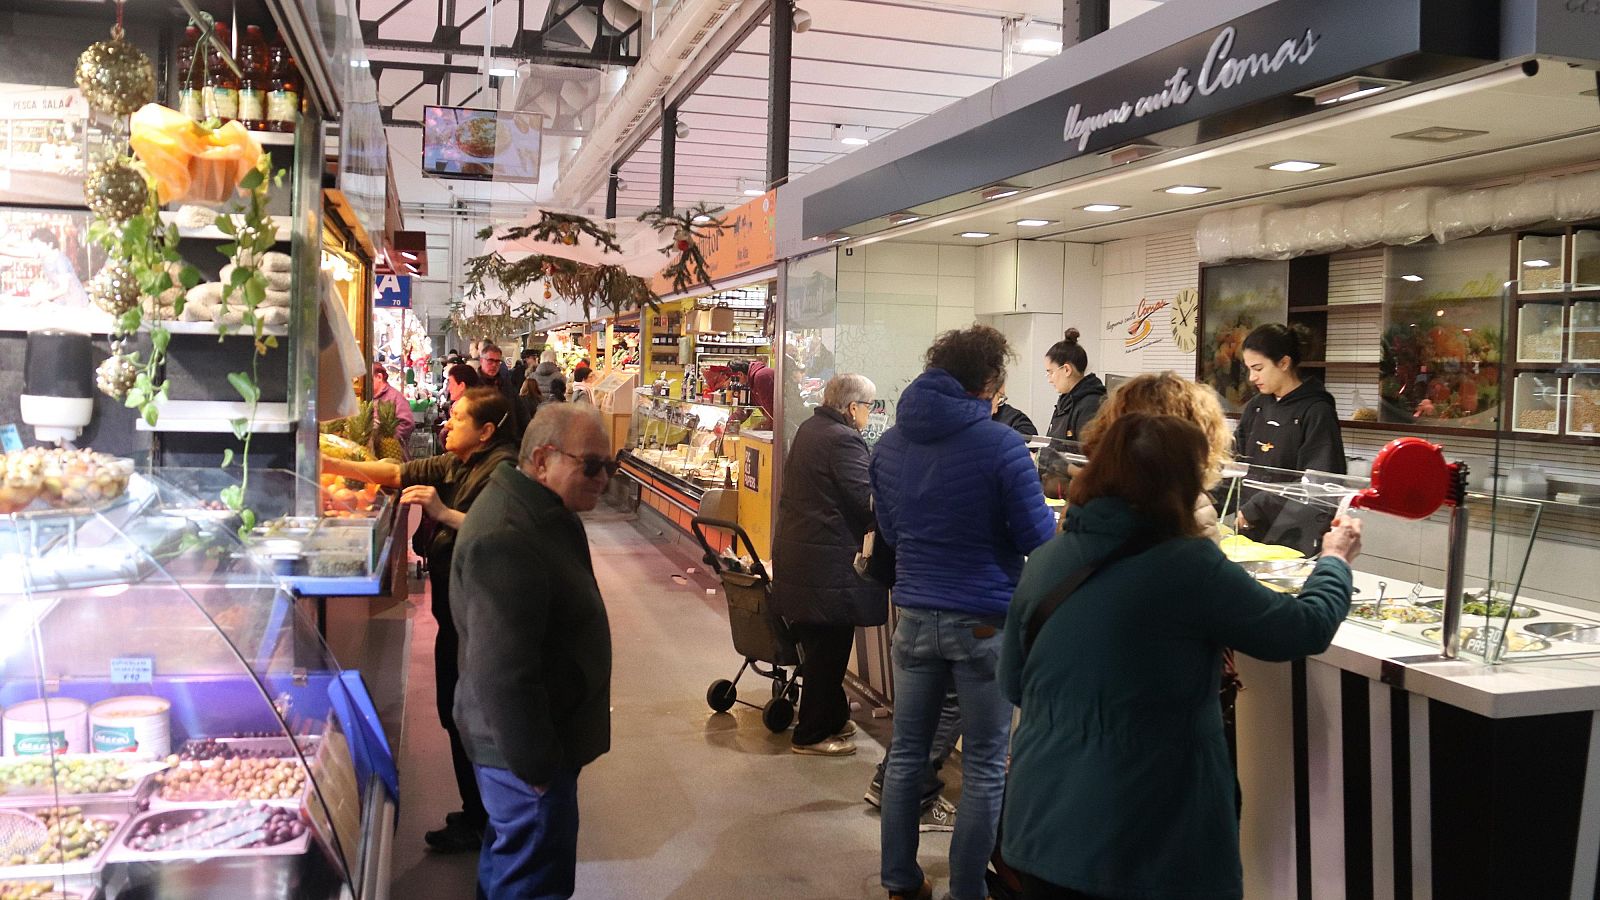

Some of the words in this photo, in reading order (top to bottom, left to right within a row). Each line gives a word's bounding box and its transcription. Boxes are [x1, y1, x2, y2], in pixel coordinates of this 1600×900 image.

[1063, 101, 1133, 152] llegums
[1134, 66, 1194, 118] cuits
[1198, 26, 1319, 95] Comas
